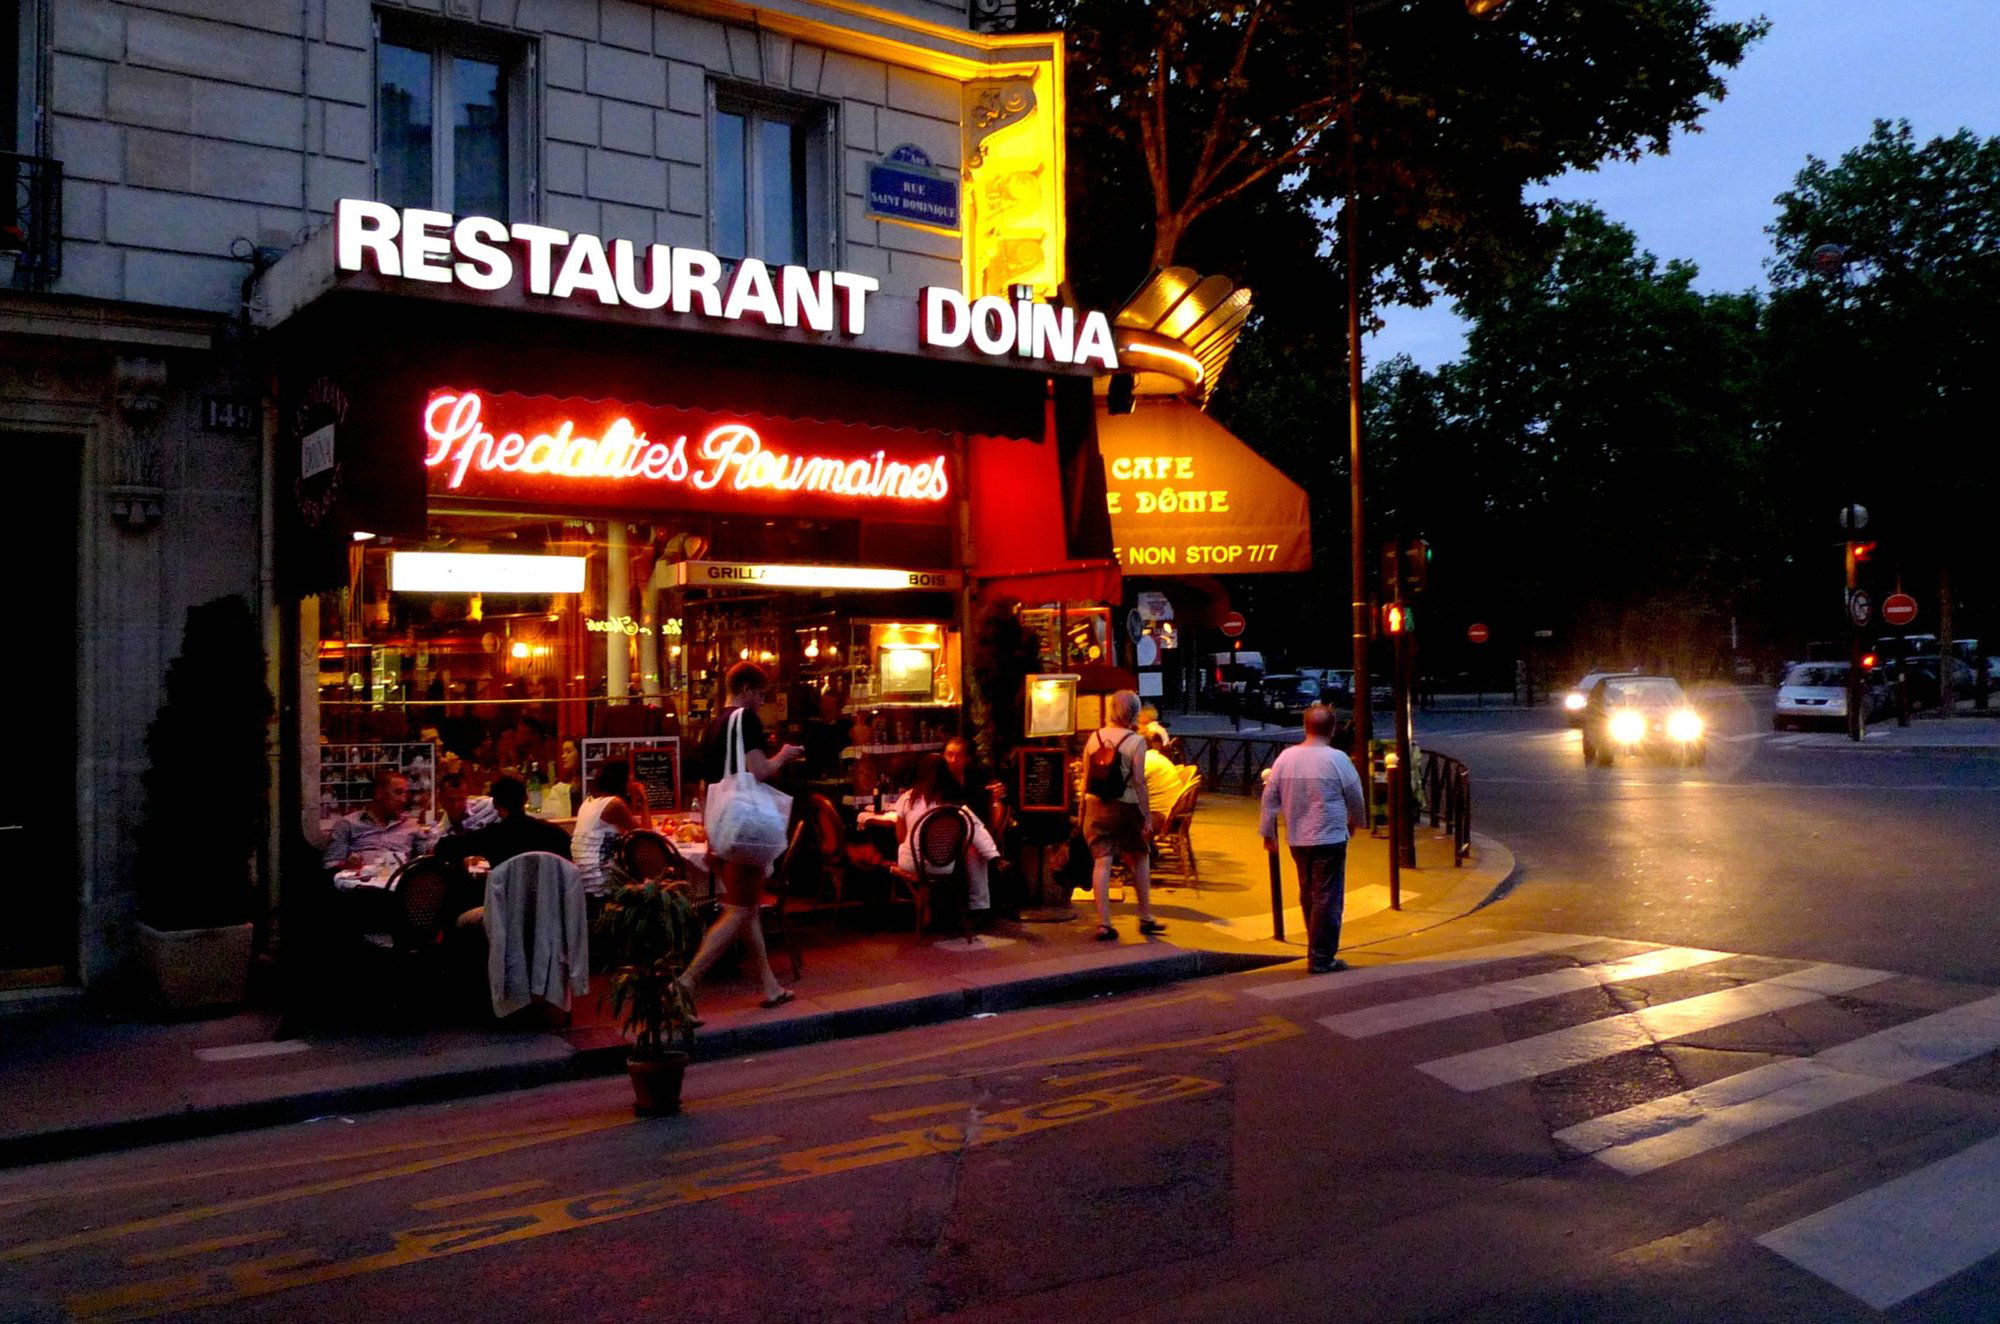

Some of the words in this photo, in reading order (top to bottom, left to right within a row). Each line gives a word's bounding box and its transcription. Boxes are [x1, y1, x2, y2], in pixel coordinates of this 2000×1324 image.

[903, 181, 926, 196] RUE
[871, 192, 901, 207] SAINT
[902, 198, 956, 218] DOMINIQUE
[336, 198, 880, 335] RESTAURANT
[923, 283, 1119, 369] DOÏNA
[209, 399, 253, 429] 149
[692, 423, 949, 501] Roumaines
[1111, 455, 1195, 481] CAFE
[1105, 491, 1122, 514] E
[1135, 487, 1230, 513] DÔME
[1129, 546, 1176, 565] NON
[1186, 545, 1242, 564] STOP
[1247, 544, 1279, 563] 7/7
[908, 574, 947, 587] BOIS
